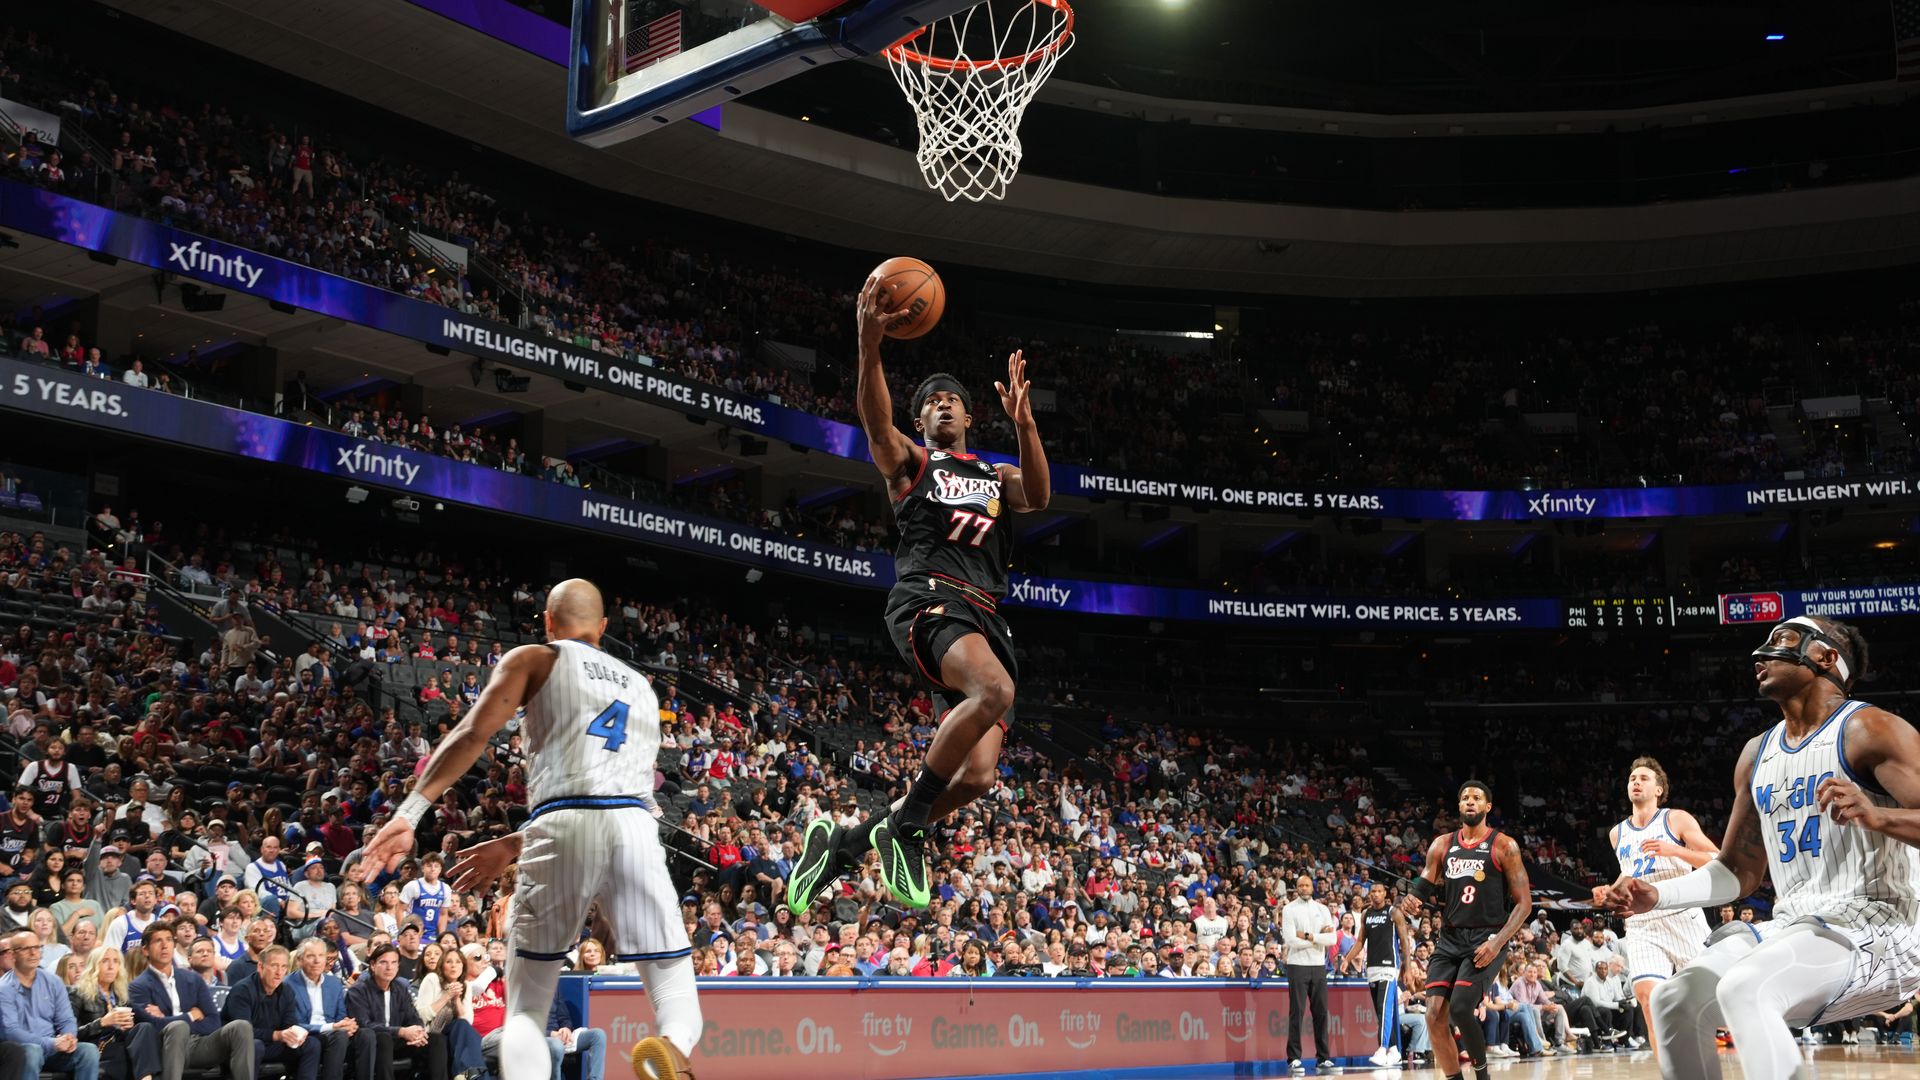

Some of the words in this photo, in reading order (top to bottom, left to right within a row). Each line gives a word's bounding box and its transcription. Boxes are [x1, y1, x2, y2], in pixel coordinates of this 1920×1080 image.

[168, 241, 263, 288] xfinity
[443, 318, 558, 365] INTELLIGENT
[562, 352, 603, 379] WIFI.
[608, 366, 643, 390] ONE
[647, 376, 696, 405] PRICE.
[701, 392, 710, 409] 5
[713, 395, 765, 425] YEARS.
[13, 374, 30, 395] 5
[36, 378, 128, 417] YEARS.
[336, 444, 420, 485] xfinity
[1080, 474, 1177, 497] INTELLIGENT
[1180, 484, 1218, 501] WIFI.
[1222, 488, 1253, 504] ONE
[1257, 491, 1308, 507] PRICE.
[1313, 494, 1323, 507] 5
[1327, 494, 1383, 510] YEARS.
[1529, 493, 1596, 515] xfinity
[1747, 484, 1861, 504] INTELLIGENT
[1866, 480, 1912, 496] WIFI.
[582, 500, 685, 537] INTELLIGENT
[688, 523, 726, 546] WIFI.
[730, 533, 762, 554] ONE
[765, 541, 809, 564] PRICE.
[813, 552, 822, 567] 5
[825, 554, 876, 577] YEARS.
[947, 509, 996, 546] 77
[1012, 579, 1071, 607] xfinity
[1801, 592, 1819, 602] BUY
[1822, 590, 1846, 601] YOUR
[1849, 588, 1875, 600] 50/50
[1878, 586, 1915, 598] TICKETS
[1209, 599, 1307, 618] INTELLIGENT
[1311, 604, 1351, 619] WIFI.
[1355, 605, 1389, 620] ONE
[1393, 606, 1444, 621] PRICE.
[1450, 607, 1459, 621] 5
[1462, 607, 1521, 621] YEARS.
[1569, 607, 1586, 616] PHI
[1597, 607, 1603, 616] 3
[1617, 606, 1623, 615] 2
[1636, 606, 1643, 615] 0
[1657, 606, 1662, 615] 1
[1677, 606, 1698, 616] 7:48
[1700, 606, 1716, 615] PM
[1729, 603, 1744, 615] 50
[1762, 601, 1777, 613] 50
[1805, 602, 1856, 616] CURRENT
[1859, 600, 1898, 613] TOTAL:
[1568, 618, 1587, 627] ORL
[1597, 617, 1604, 626] 4
[1617, 617, 1623, 626] 2
[1638, 617, 1643, 626] 1
[1656, 616, 1663, 625] 0
[585, 699, 631, 752] 4
[44, 794, 60, 804] 21
[1777, 815, 1821, 863] 34
[1632, 854, 1656, 878] 22
[1461, 885, 1476, 904] 8
[425, 908, 435, 922] 9
[611, 1016, 649, 1043] fire
[701, 1020, 792, 1057] Game.
[796, 1017, 842, 1054] On.
[862, 1012, 892, 1036] fire
[896, 1014, 913, 1036] tv
[931, 1016, 1005, 1049] Game.
[1008, 1013, 1044, 1048] On.
[1060, 1009, 1084, 1031] fire
[1086, 1011, 1102, 1031] tv
[1115, 1011, 1176, 1043] Game.
[1179, 1011, 1209, 1041] On.
[1221, 1007, 1242, 1027] fire
[1245, 1009, 1256, 1026] tv
[1355, 1005, 1373, 1024] fire
